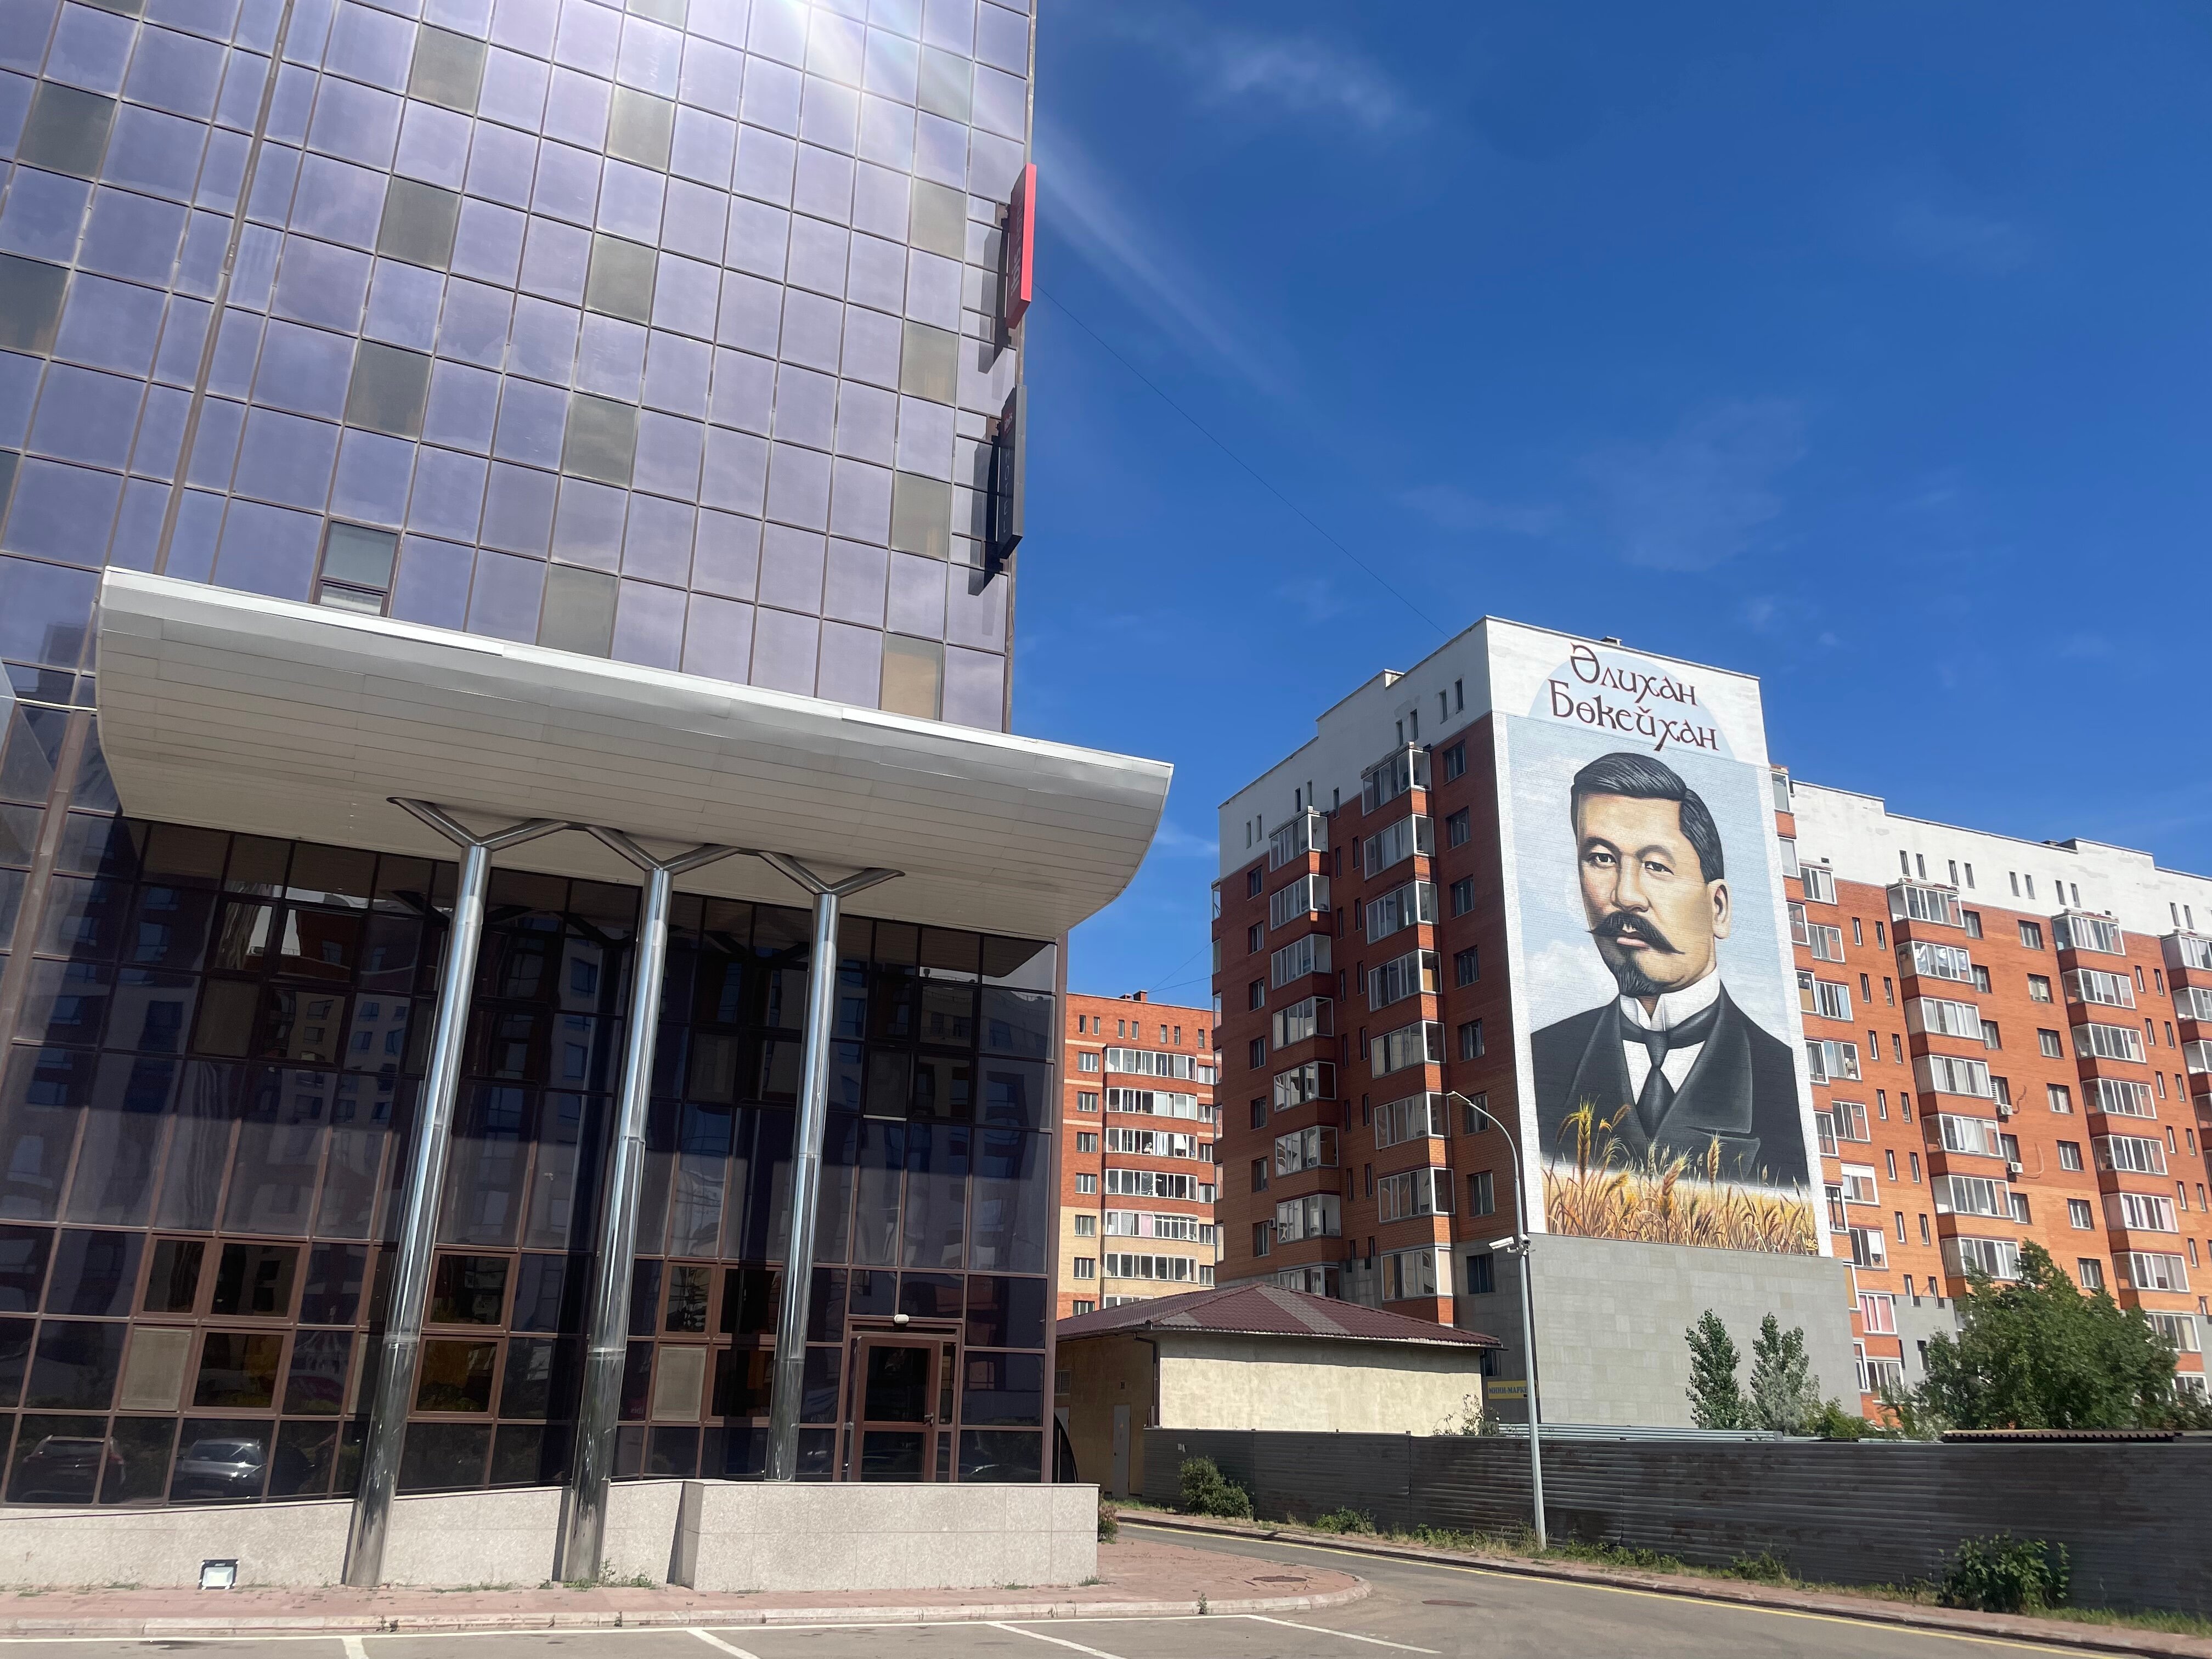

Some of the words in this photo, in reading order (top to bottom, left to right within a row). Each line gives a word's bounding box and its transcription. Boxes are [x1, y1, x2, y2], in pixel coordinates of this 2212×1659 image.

[1011, 246, 1021, 297] ibis
[1570, 642, 1698, 706] Әлихан
[1548, 679, 1720, 752] Бөкейхан
